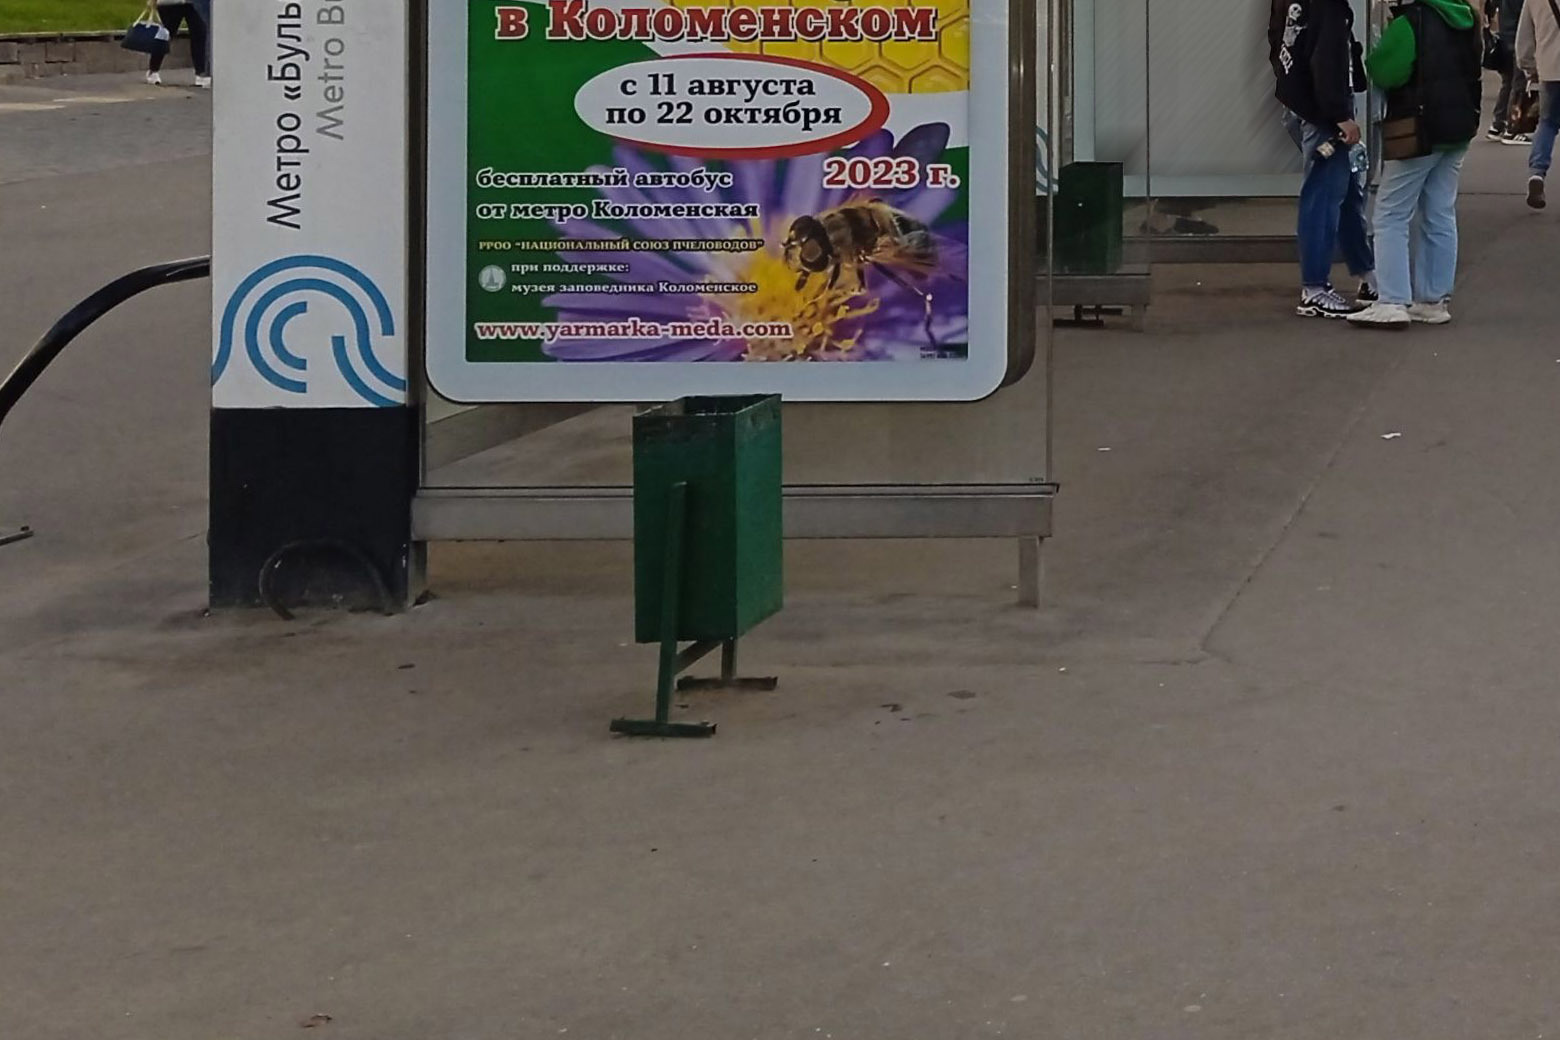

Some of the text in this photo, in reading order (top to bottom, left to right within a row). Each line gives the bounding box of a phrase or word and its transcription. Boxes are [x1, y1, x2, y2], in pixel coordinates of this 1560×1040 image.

[494, 5, 529, 40] в
[315, 36, 345, 141] Metro
[619, 72, 816, 102] с 11 августа
[605, 101, 842, 130] по 22 октября
[266, 112, 310, 230] Метро
[476, 166, 733, 192] бесплатный автобус
[823, 158, 961, 188] 2023 г.
[476, 199, 760, 223] от метро Коломенская
[632, 240, 670, 251] СОЮЗ
[510, 262, 630, 275] при поддержке:
[511, 280, 758, 295] музея заповедника Коломенское
[474, 318, 793, 343] www.yarmarka-meda.com
